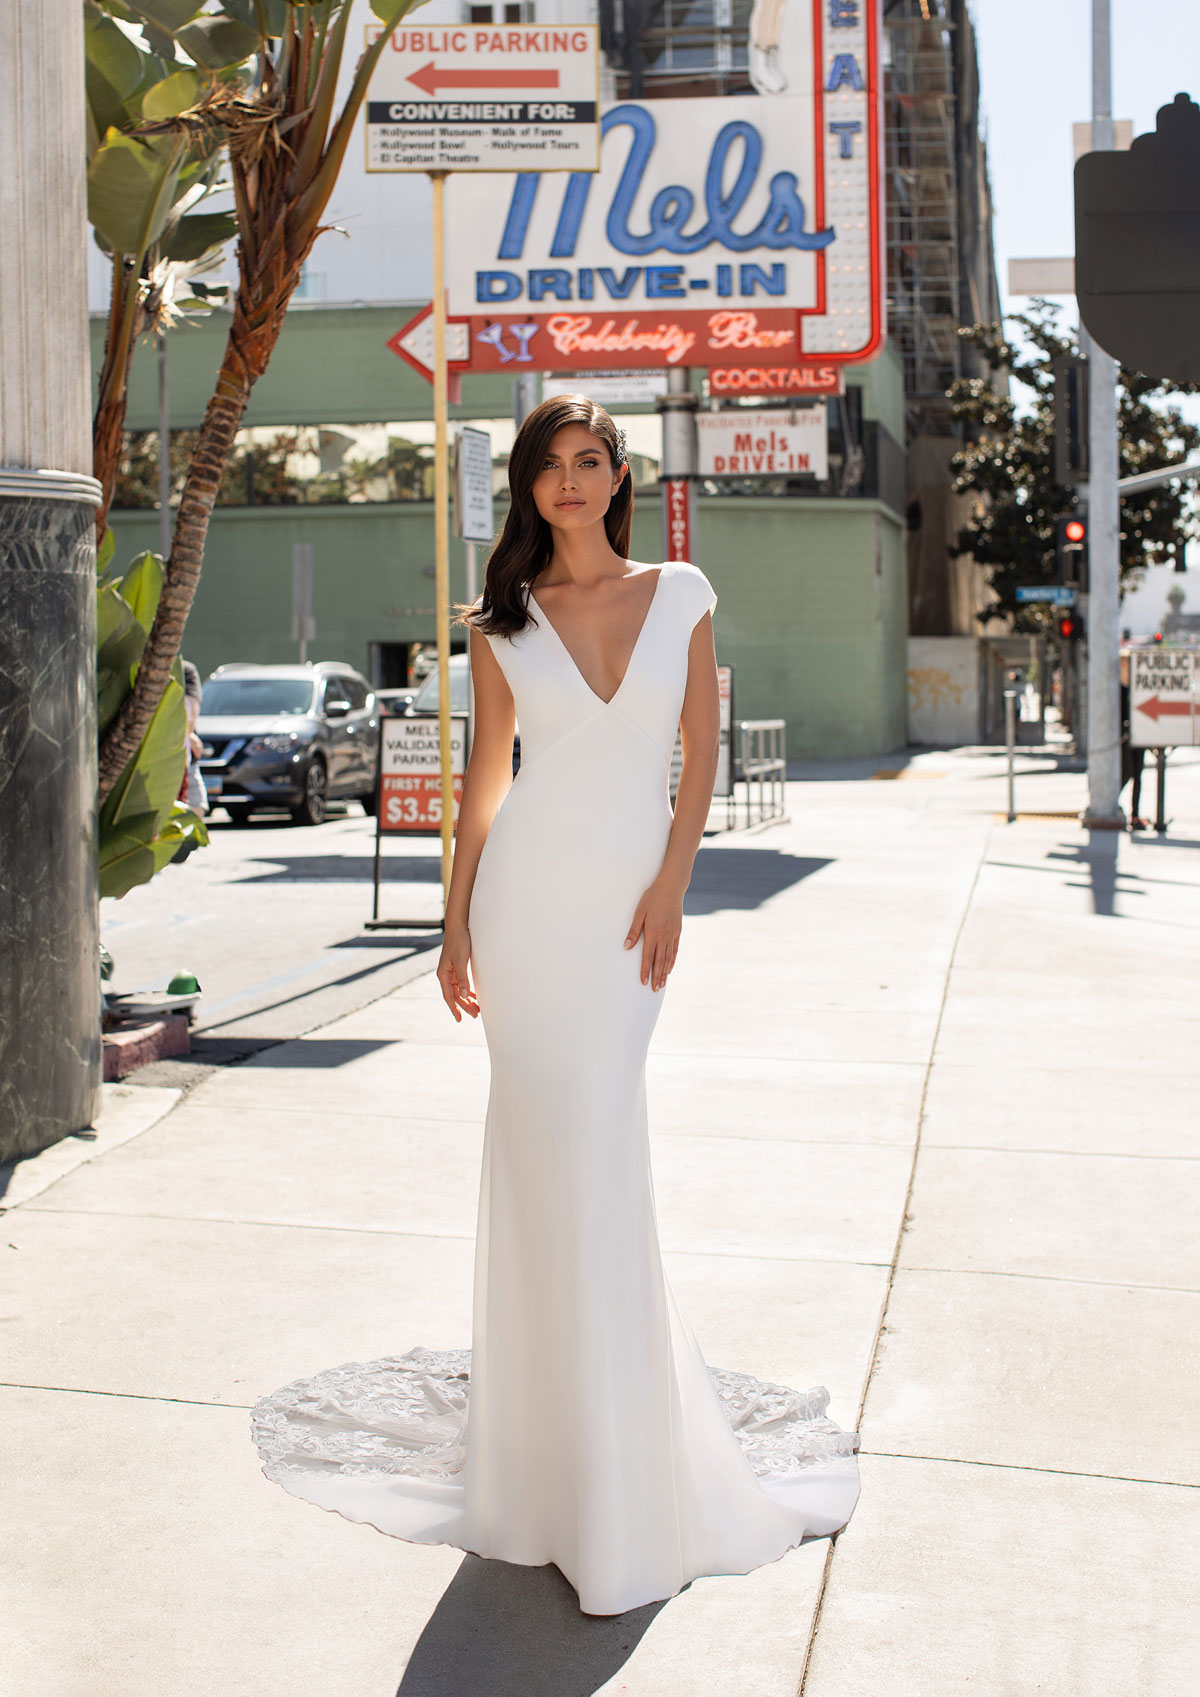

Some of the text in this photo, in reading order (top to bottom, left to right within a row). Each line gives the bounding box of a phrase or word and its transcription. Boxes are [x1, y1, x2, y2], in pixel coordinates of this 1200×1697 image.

[475, 31, 589, 53] PARKING
[825, 0, 866, 160] EAT
[389, 104, 576, 120] CONVENIENT FOR:
[380, 127, 563, 139] Hollywood Museum Walk of Fame
[380, 141, 435, 152] Hollywood
[491, 141, 547, 152] Hollywood
[551, 141, 579, 150] Tours
[394, 154, 434, 164] Capitan
[438, 153, 480, 163] Theatre
[497, 104, 836, 260] Mels
[475, 263, 786, 303] DRIVE-IN
[547, 311, 796, 363] Celebrity Bar
[711, 367, 837, 390] COCKTAILS
[733, 431, 789, 453] Mels
[713, 453, 810, 473] DRIVE-IN
[1136, 654, 1190, 670] PUBLIC
[1135, 673, 1190, 691] PARKING
[387, 740, 460, 750] VALIDATD
[393, 754, 453, 764] PARKIN
[384, 777, 463, 791] FIRST HOR
